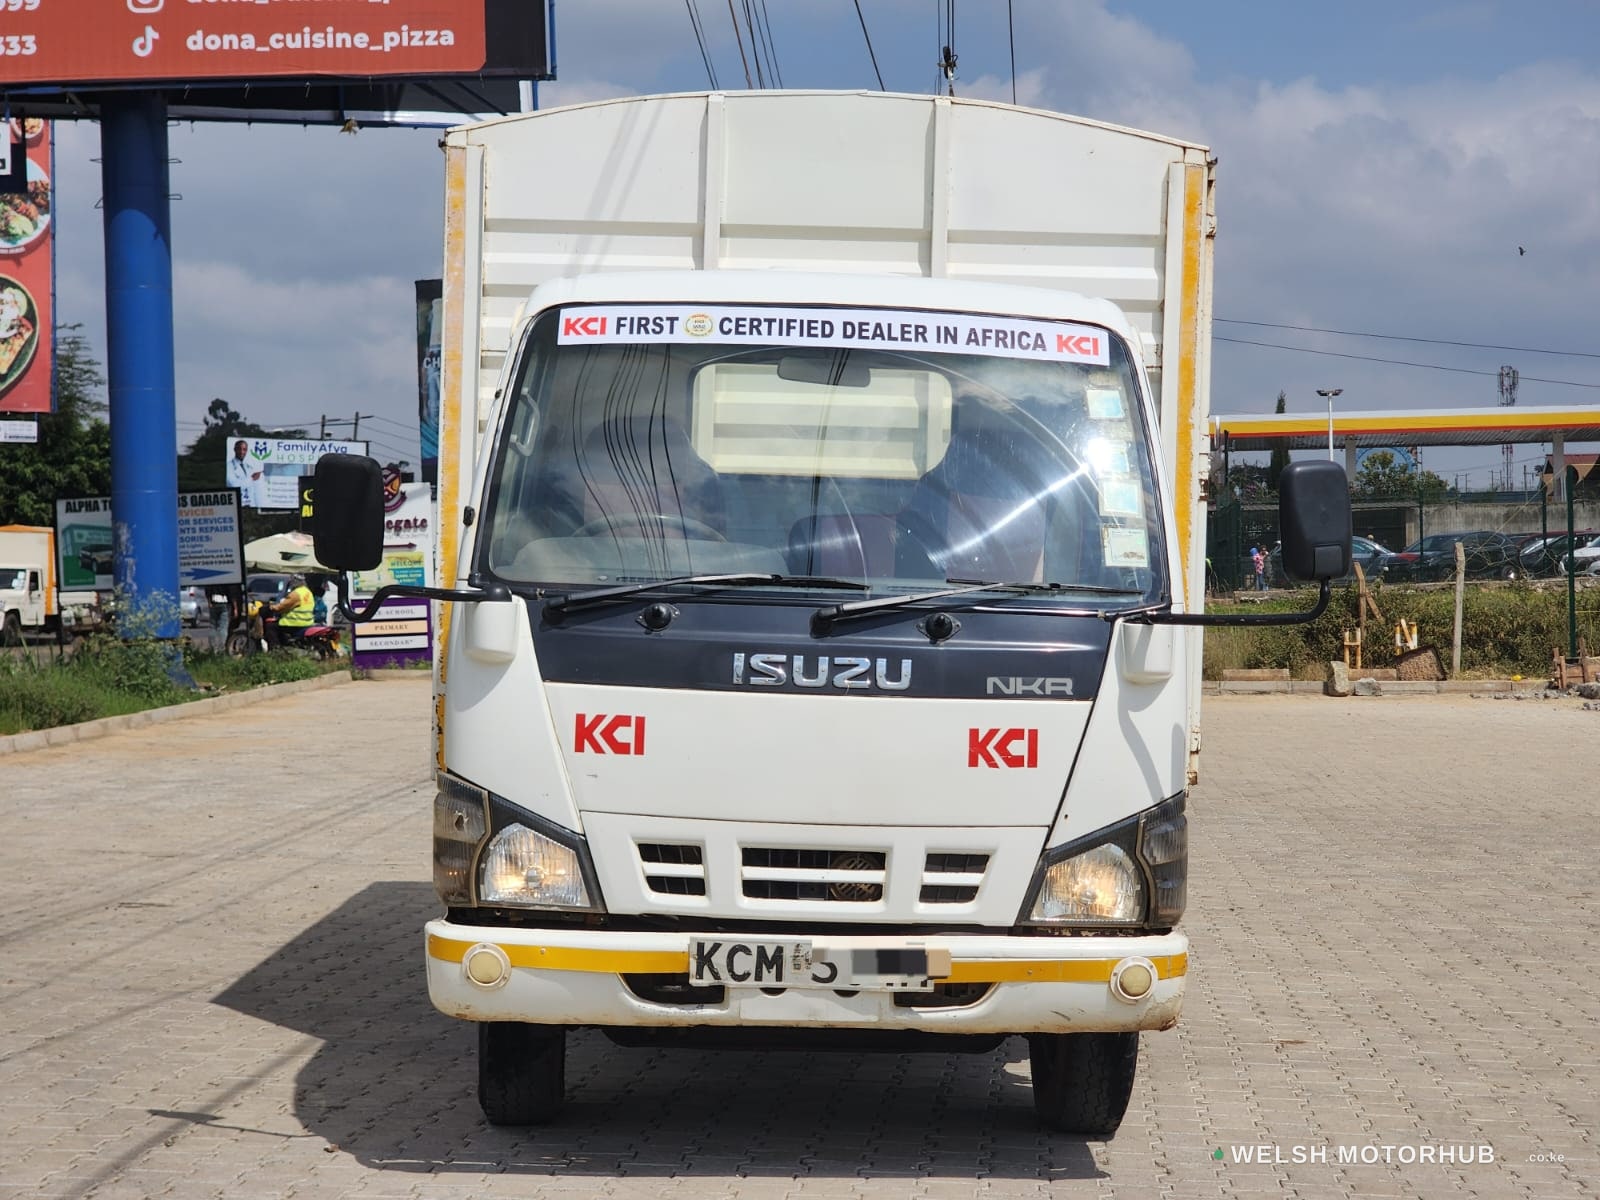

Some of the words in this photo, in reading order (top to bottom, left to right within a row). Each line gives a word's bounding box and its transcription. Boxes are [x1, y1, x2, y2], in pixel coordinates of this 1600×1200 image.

[186, 24, 455, 52] dona_cuisine_pizza
[563, 316, 608, 336] KCI
[615, 316, 679, 335] FIRST
[718, 316, 835, 338] CERTIFIED
[842, 321, 928, 343] DEALER
[936, 326, 958, 345] IN
[965, 328, 1047, 351] AFRICA
[1056, 334, 1099, 356] KCI
[65, 500, 100, 513] ALPHA
[190, 493, 233, 507] GARAGE
[192, 516, 234, 525] SERVICES
[199, 525, 234, 533] REPAIRS
[732, 652, 912, 690] ISUZU
[985, 676, 1074, 696] NKR
[574, 713, 646, 756] KCI
[967, 728, 1038, 769] KCI
[695, 941, 784, 983] KCM
